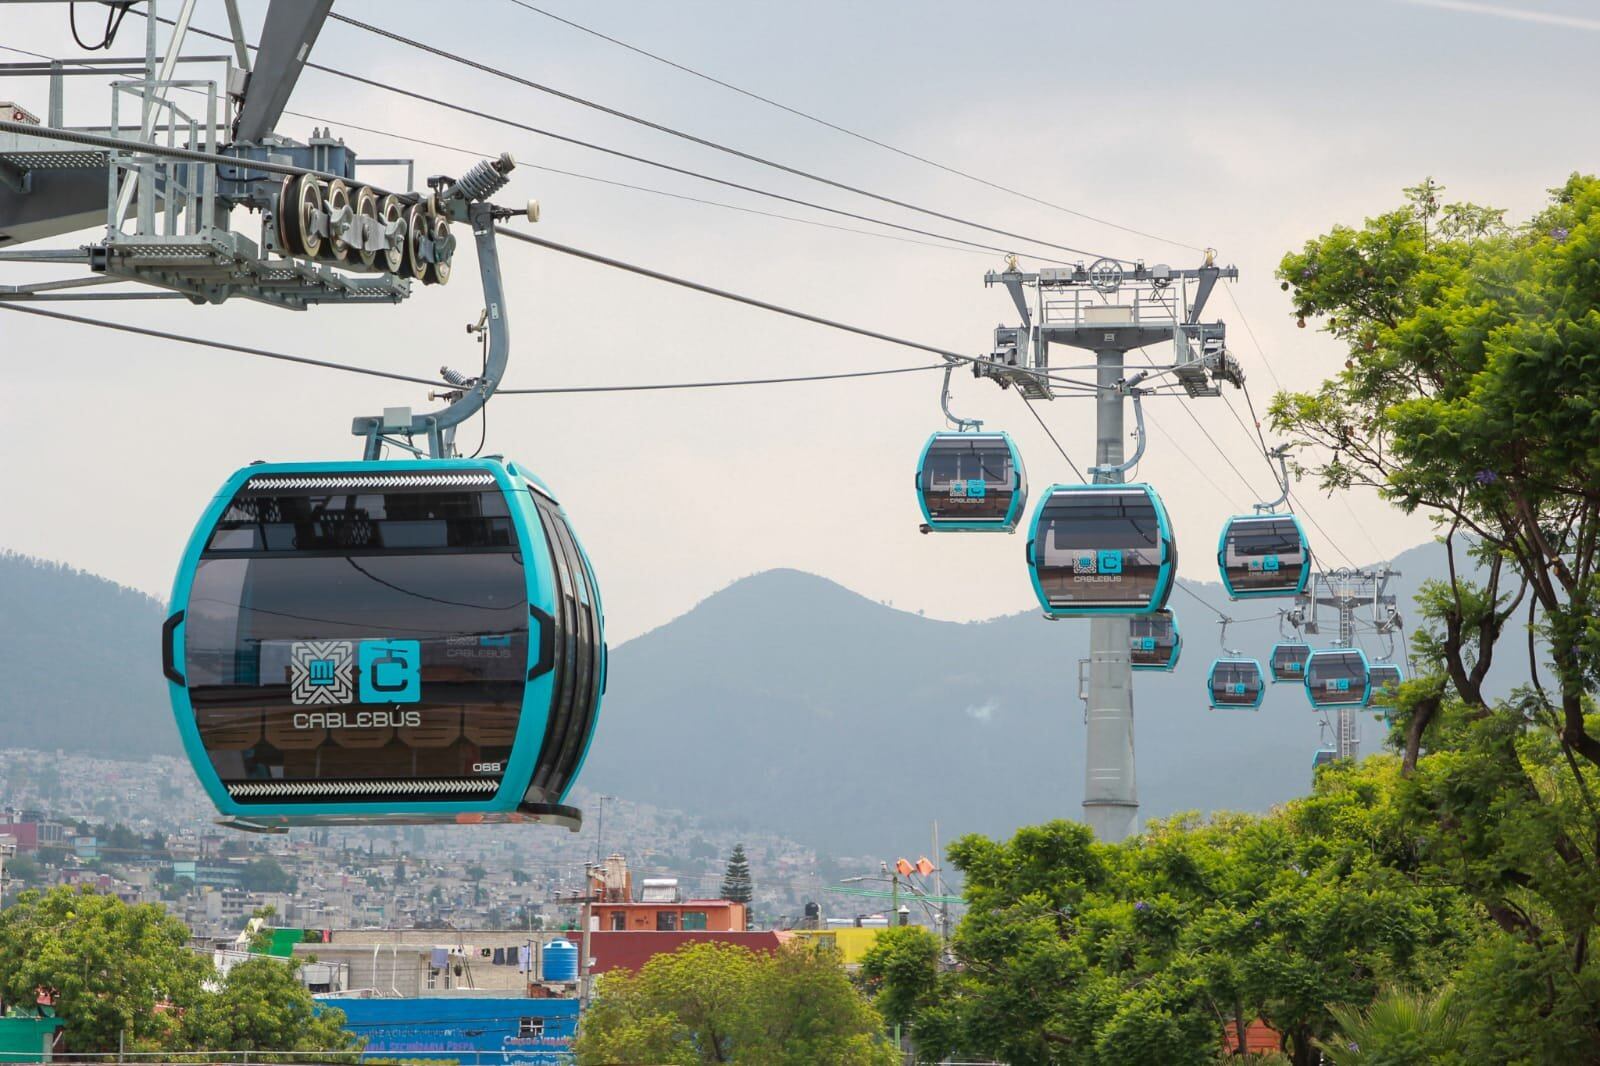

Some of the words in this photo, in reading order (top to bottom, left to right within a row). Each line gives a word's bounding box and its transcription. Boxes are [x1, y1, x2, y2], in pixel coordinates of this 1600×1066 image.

[371, 656, 409, 692] C
[293, 705, 421, 729] CABLEBÚS
[472, 762, 501, 772] 068
